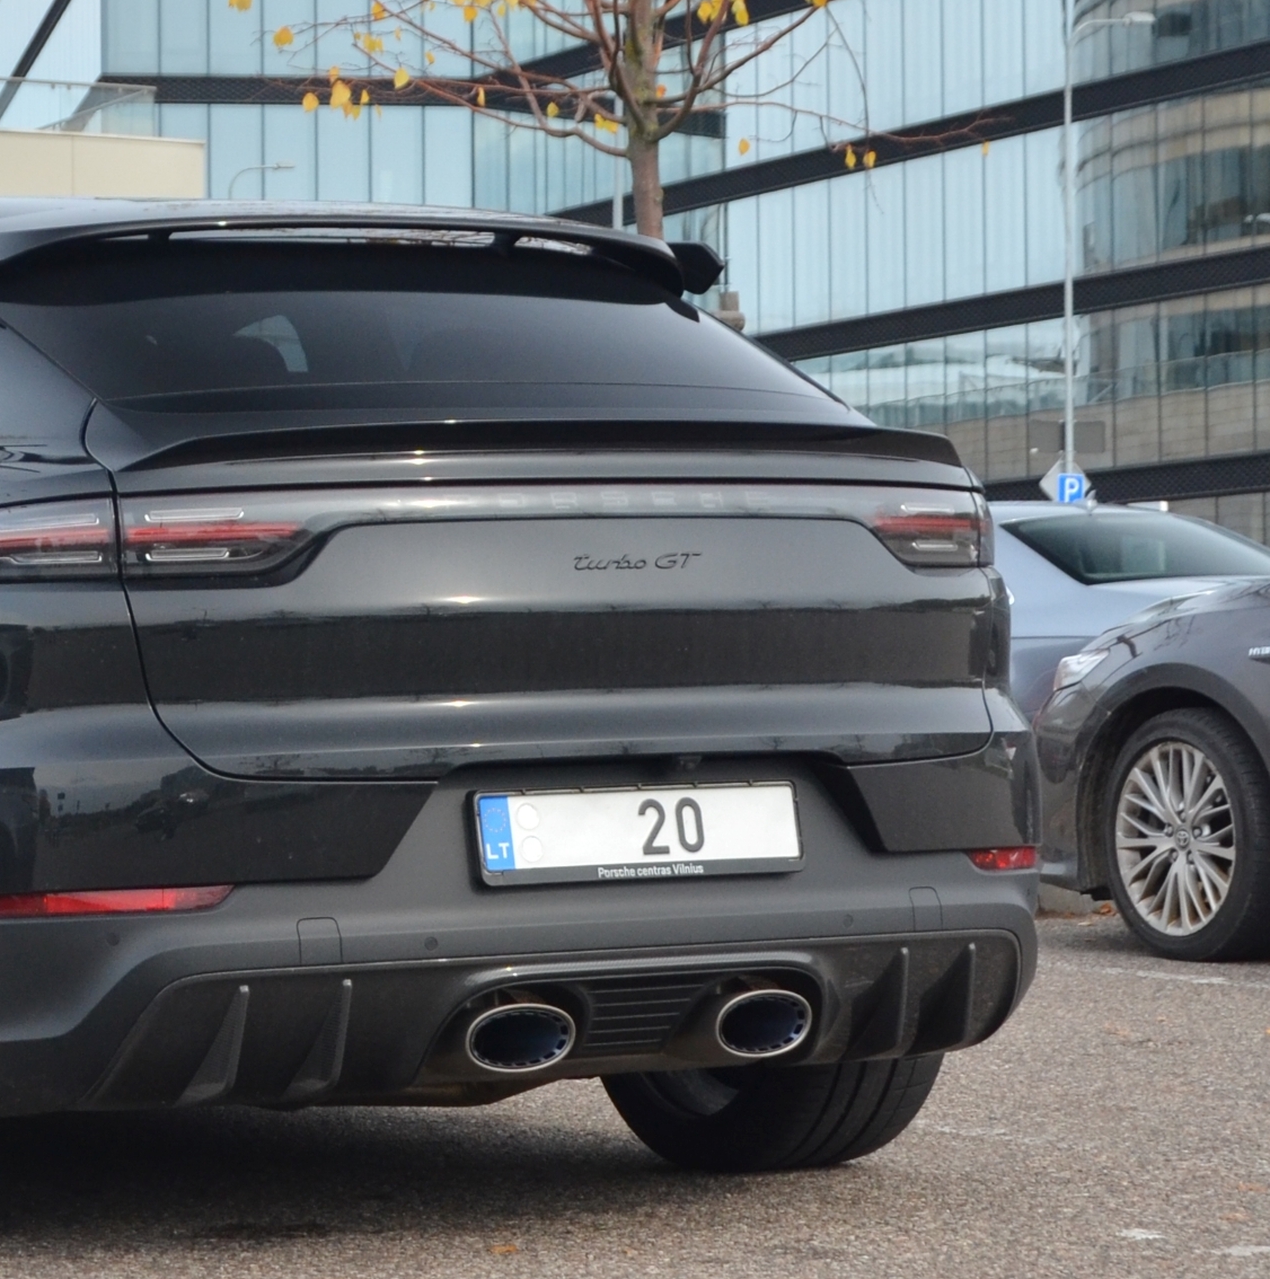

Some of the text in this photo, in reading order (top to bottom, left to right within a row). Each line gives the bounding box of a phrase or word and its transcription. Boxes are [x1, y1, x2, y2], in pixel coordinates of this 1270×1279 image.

[1064, 477, 1080, 503] P
[654, 552, 703, 570] GT
[637, 796, 705, 855] 20
[486, 842, 510, 860] LT
[597, 862, 705, 879] Porsche centras Vilnius
